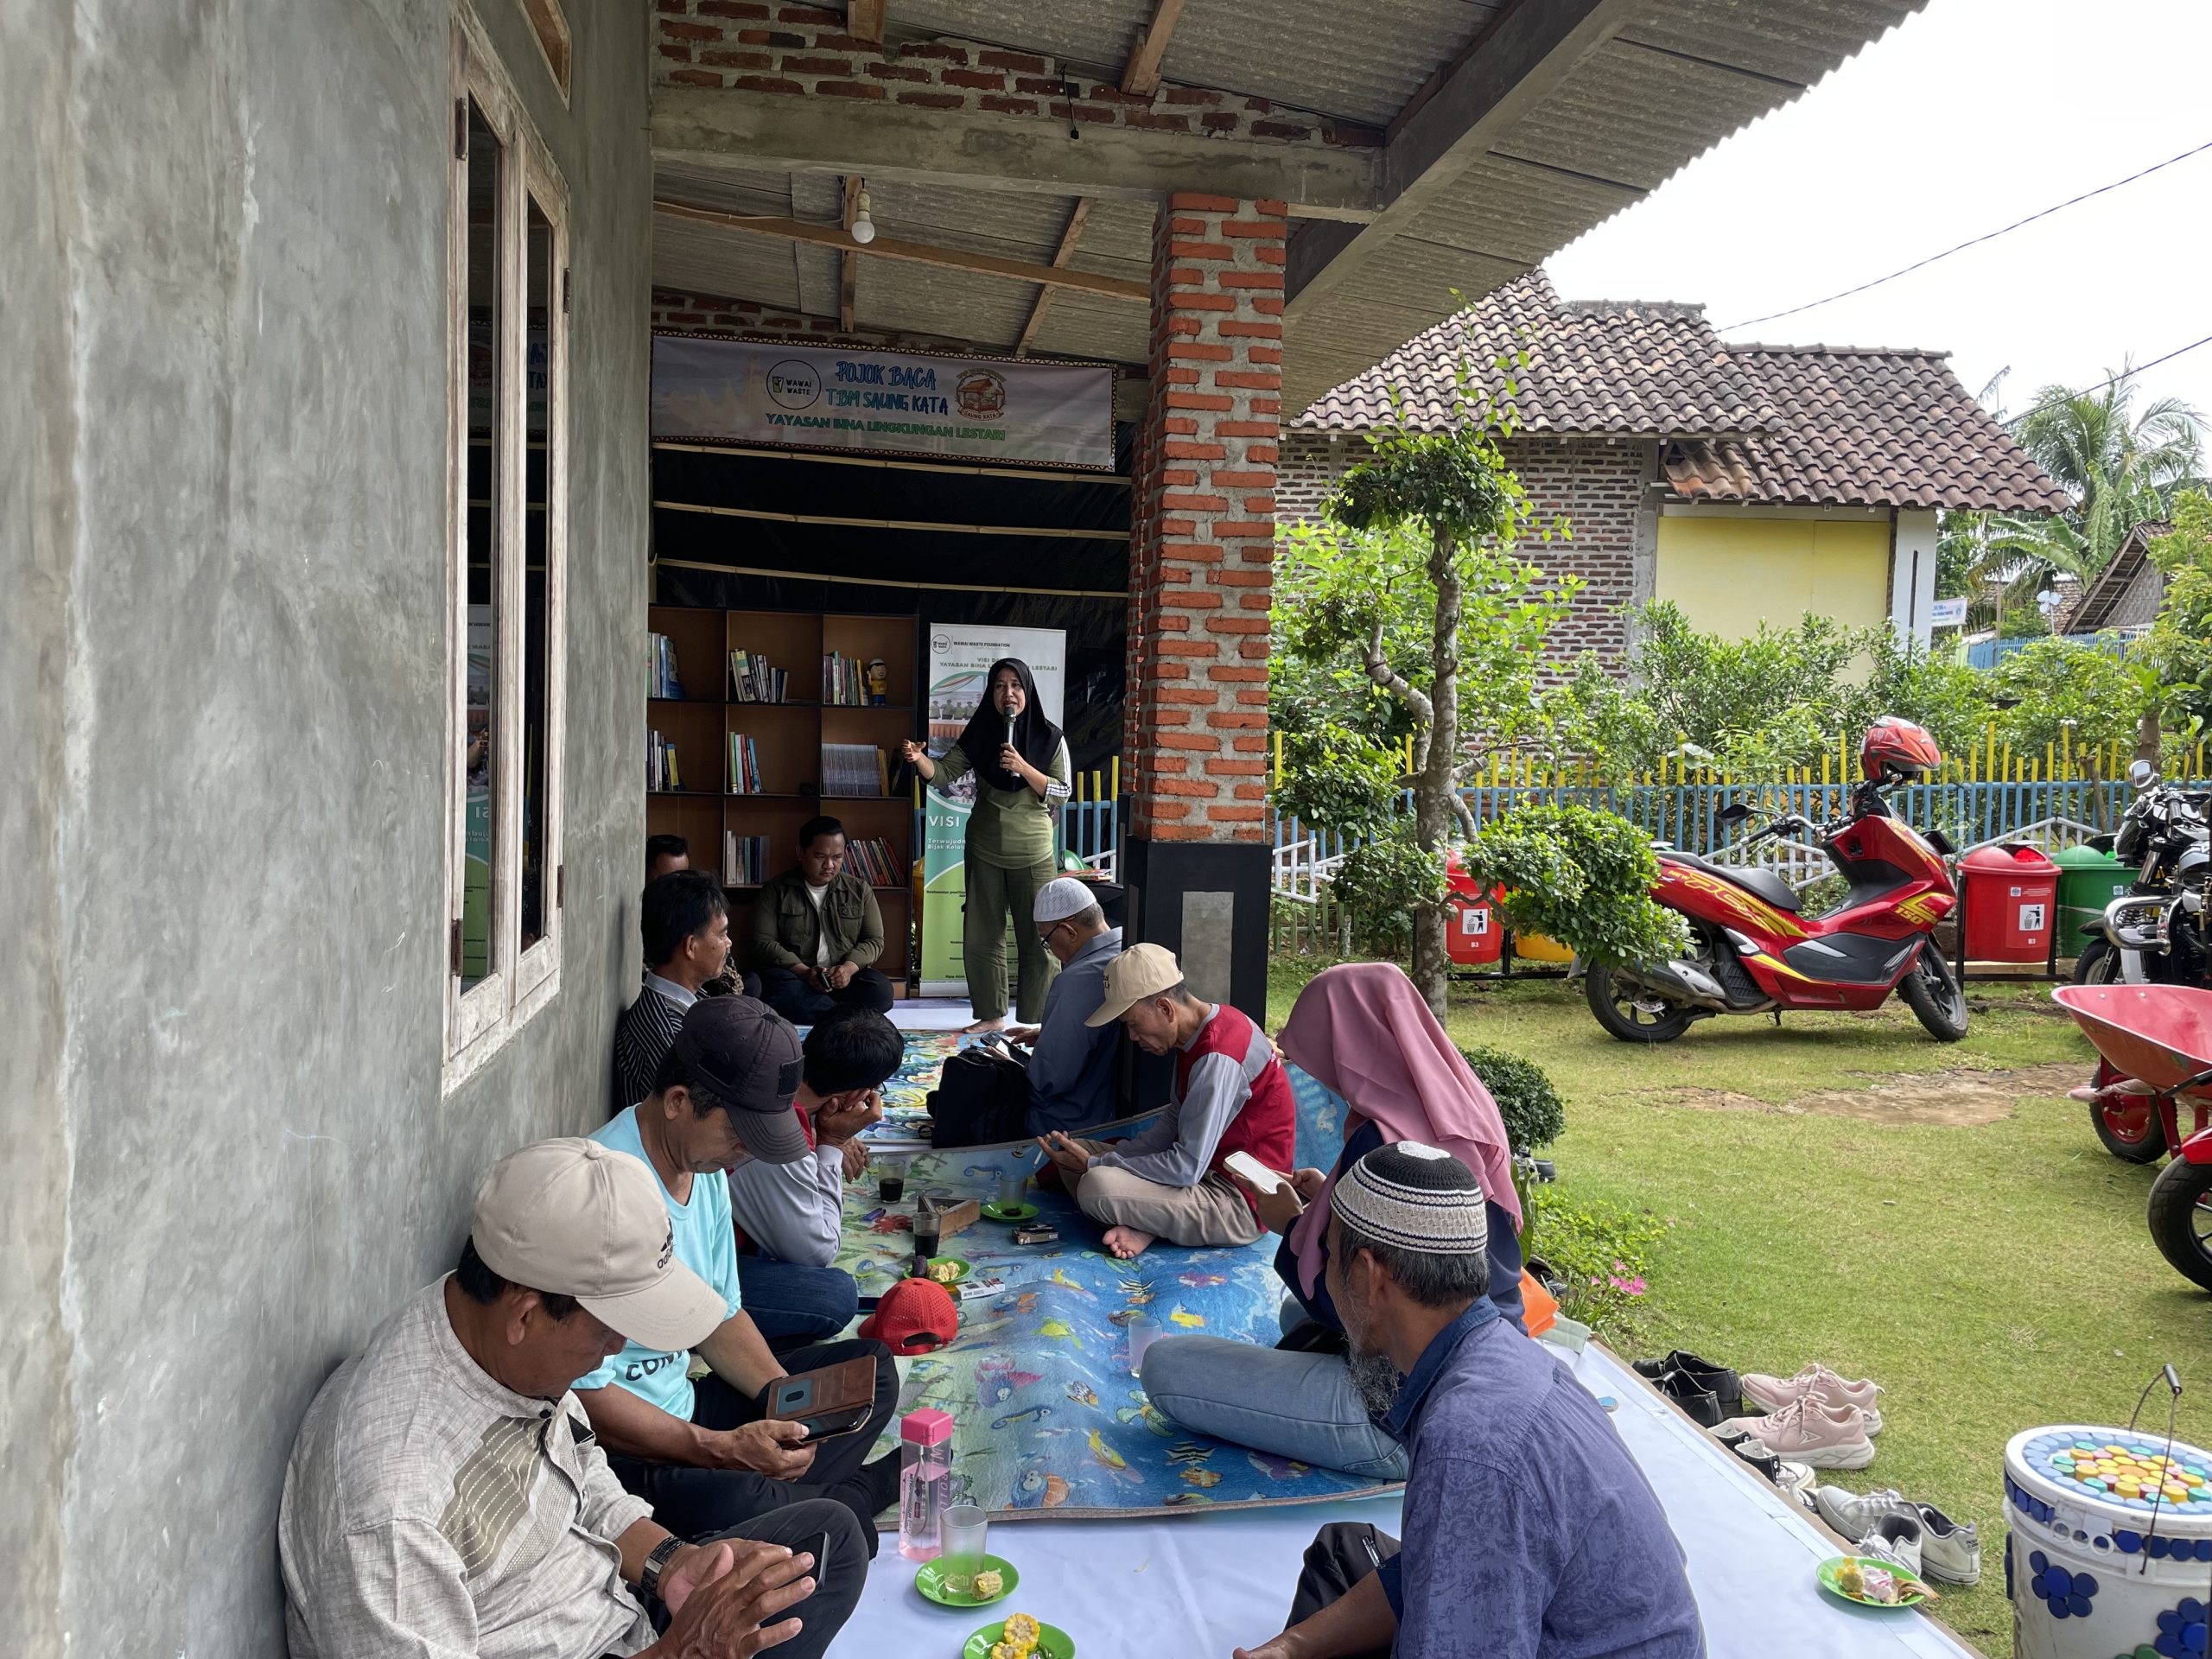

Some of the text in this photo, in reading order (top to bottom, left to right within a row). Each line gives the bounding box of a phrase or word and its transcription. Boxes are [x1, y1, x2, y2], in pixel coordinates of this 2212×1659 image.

[786, 379, 812, 388] WAWAI
[836, 361, 885, 385] POJOK
[888, 365, 936, 391] BACA
[826, 388, 948, 416] TBM SAUNG KATA
[766, 413, 1006, 441] YAYASAN BINA LINGKUNGAN LESTARI
[928, 815, 960, 827] VISI
[1894, 906, 1924, 925] 150
